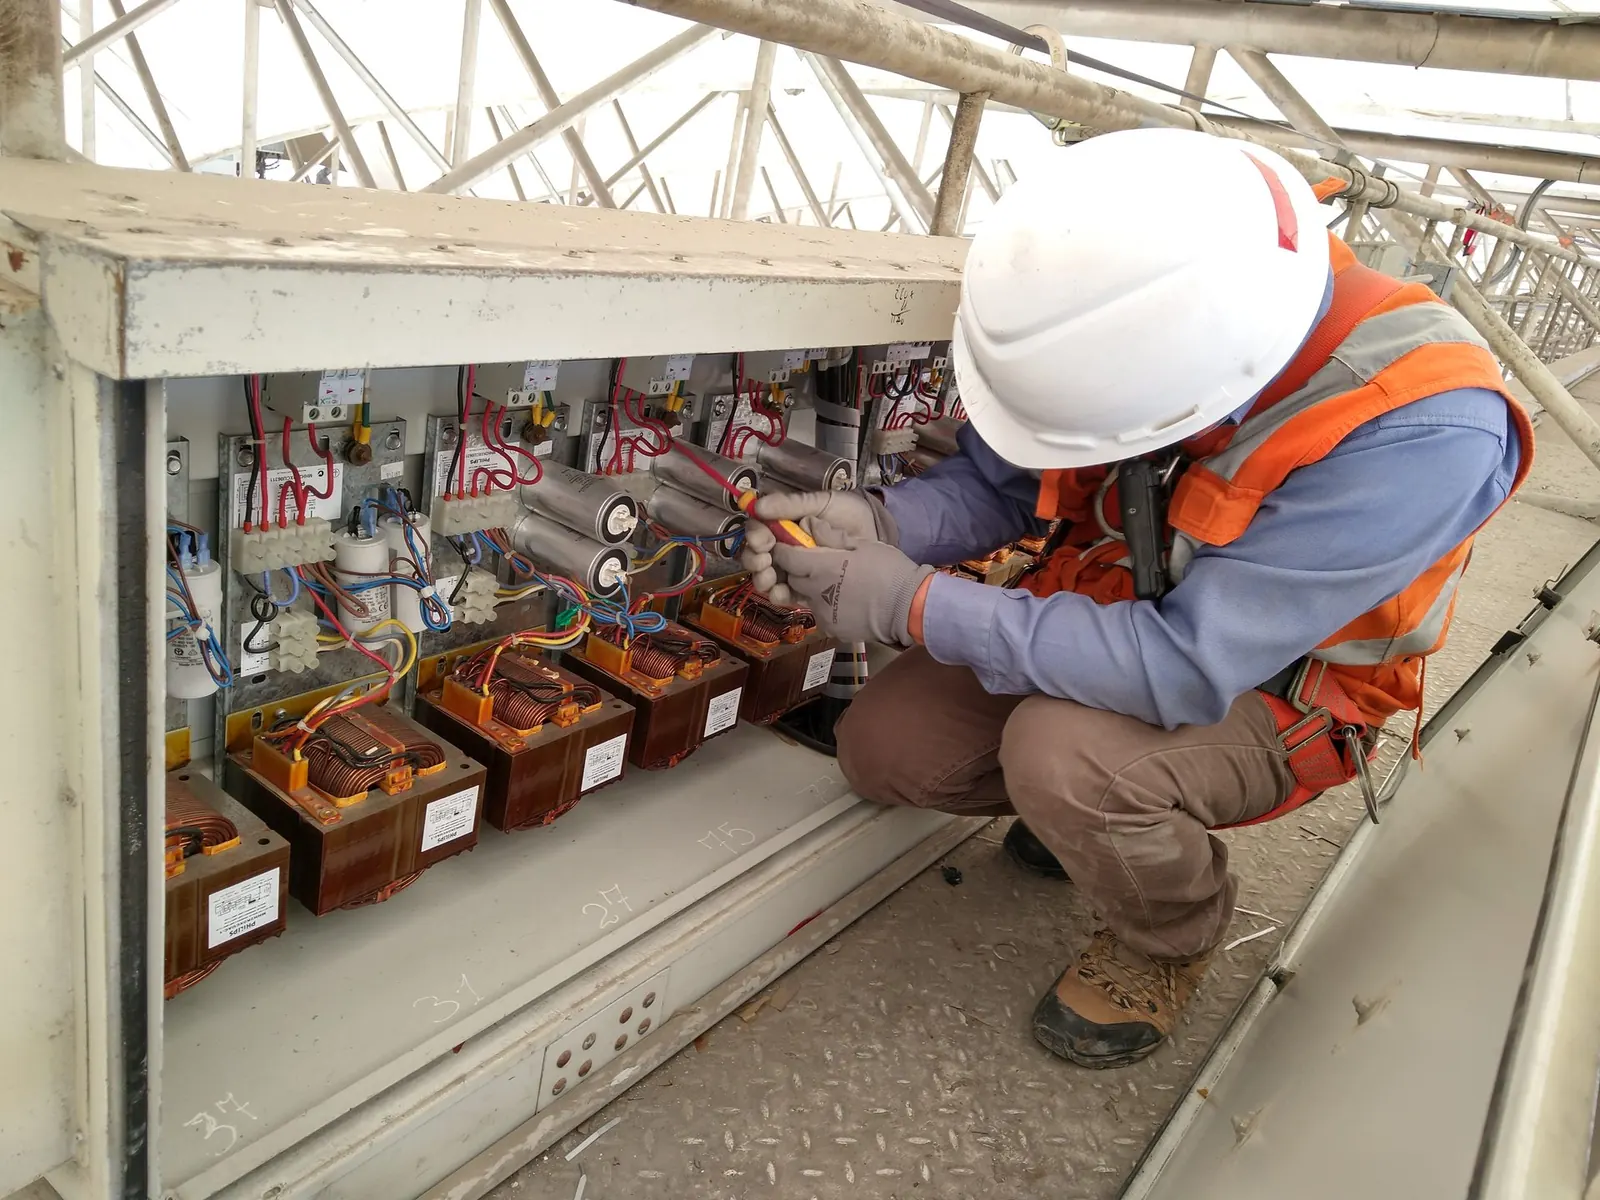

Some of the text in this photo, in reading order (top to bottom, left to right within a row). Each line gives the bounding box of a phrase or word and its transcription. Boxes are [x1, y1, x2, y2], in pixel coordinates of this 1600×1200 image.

[470, 457, 491, 465] PHILIPS
[831, 559, 849, 624] DELTAPLUS
[696, 821, 756, 855] 75
[228, 920, 257, 938] PHILIPS
[581, 883, 633, 929] 27
[412, 973, 486, 1025] 31
[182, 1091, 258, 1157] 37
